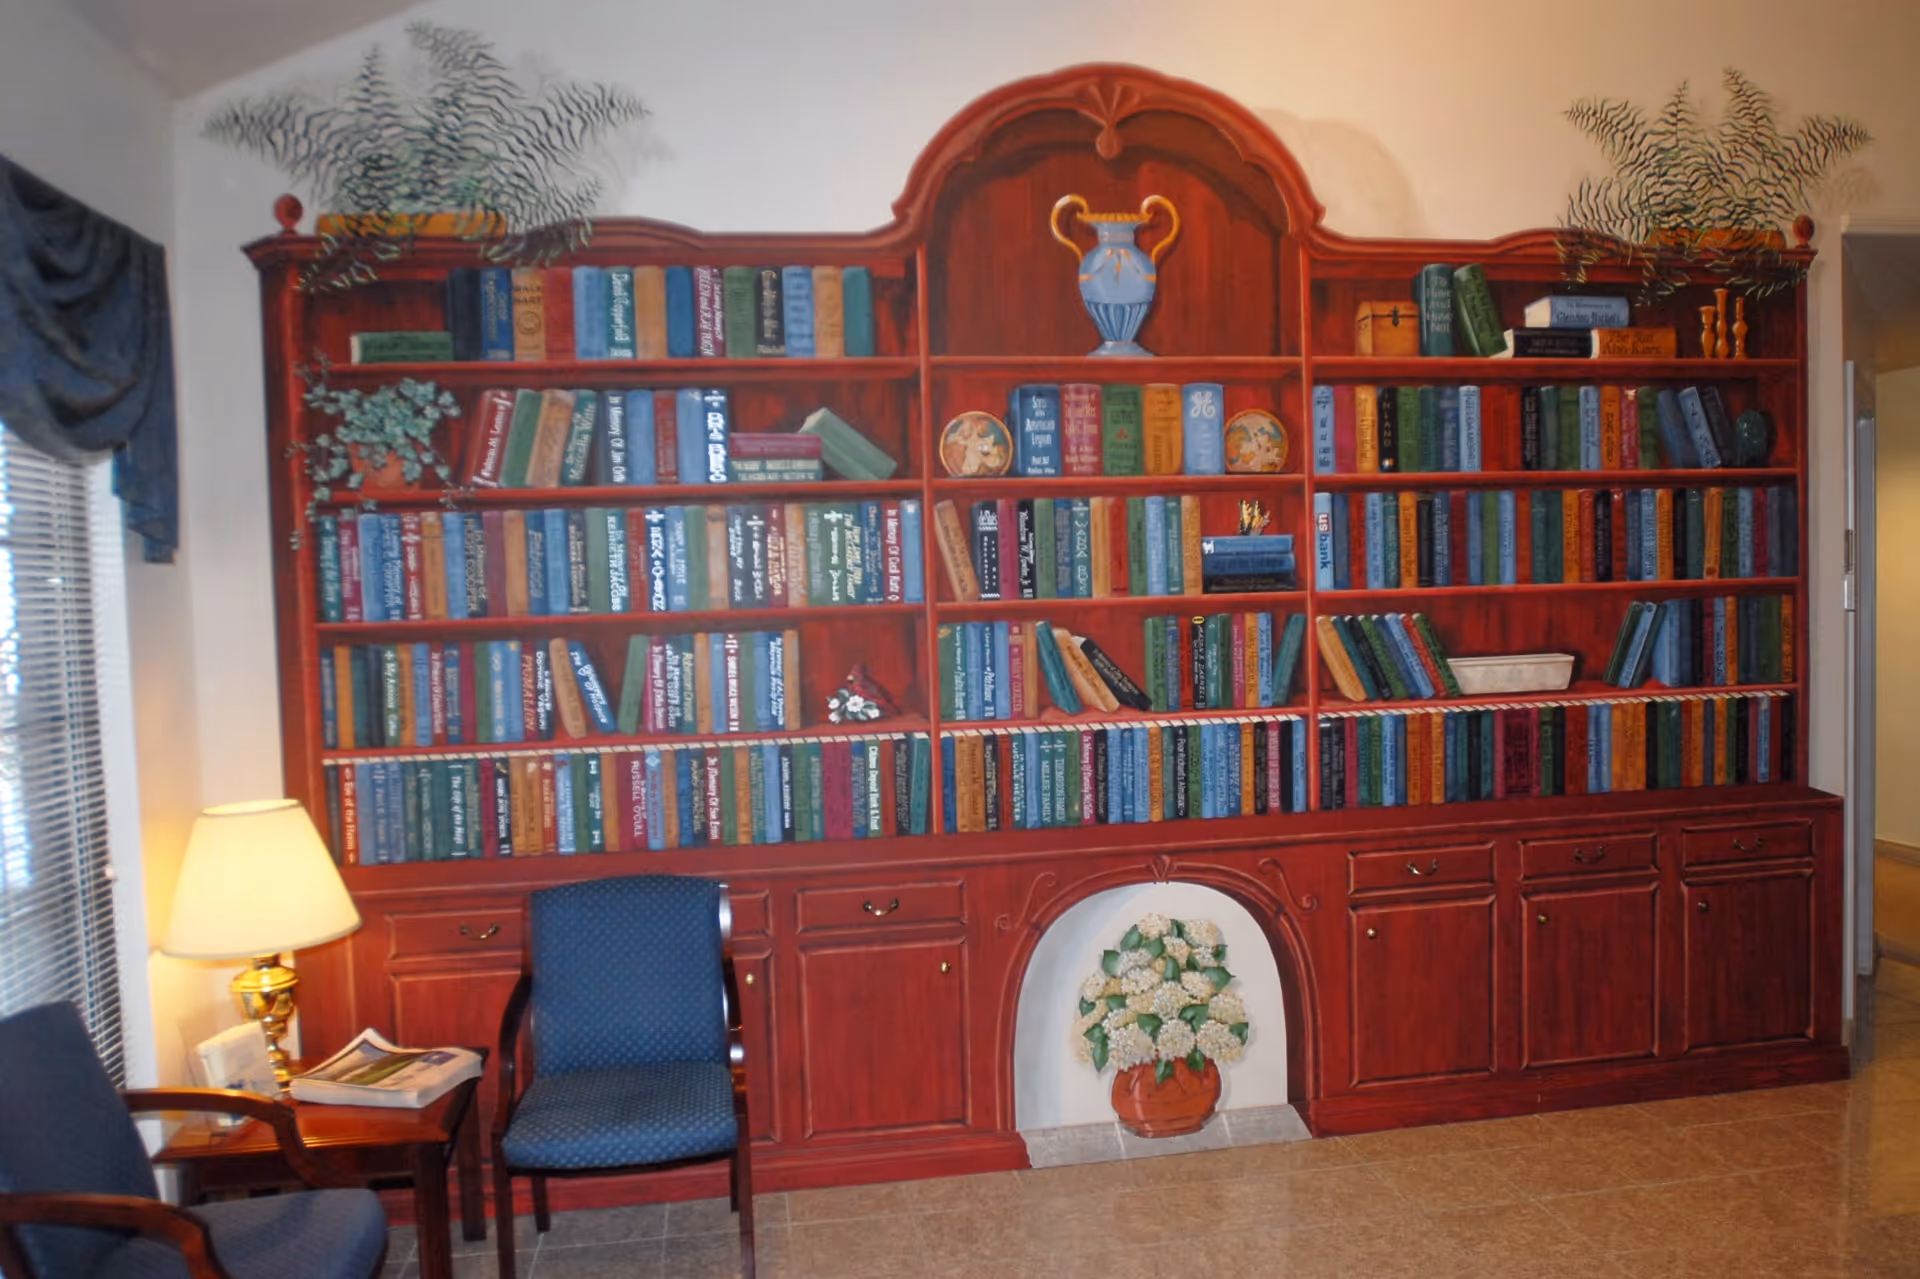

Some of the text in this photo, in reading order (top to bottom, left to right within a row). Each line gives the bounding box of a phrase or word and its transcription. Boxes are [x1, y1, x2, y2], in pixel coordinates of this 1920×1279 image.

[608, 406, 624, 435] Memory
[1025, 418, 1056, 433] American
[1031, 433, 1052, 448] Legion
[886, 518, 898, 544] Memory
[610, 569, 621, 611] JACOBS
[385, 662, 396, 676] My
[1177, 738, 1186, 752] Poor
[1012, 742, 1020, 780] LUCILLE
[452, 776, 462, 788] The
[867, 770, 879, 792] Deposit
[1042, 760, 1051, 823] MILLER FAMILY
[345, 798, 355, 806] of
[630, 760, 643, 838] RUSSELL O'CULL
[1178, 782, 1187, 808] Almanac
[454, 814, 464, 825] the
[1056, 797, 1066, 821] FAMILY
[870, 816, 880, 830] Trust
